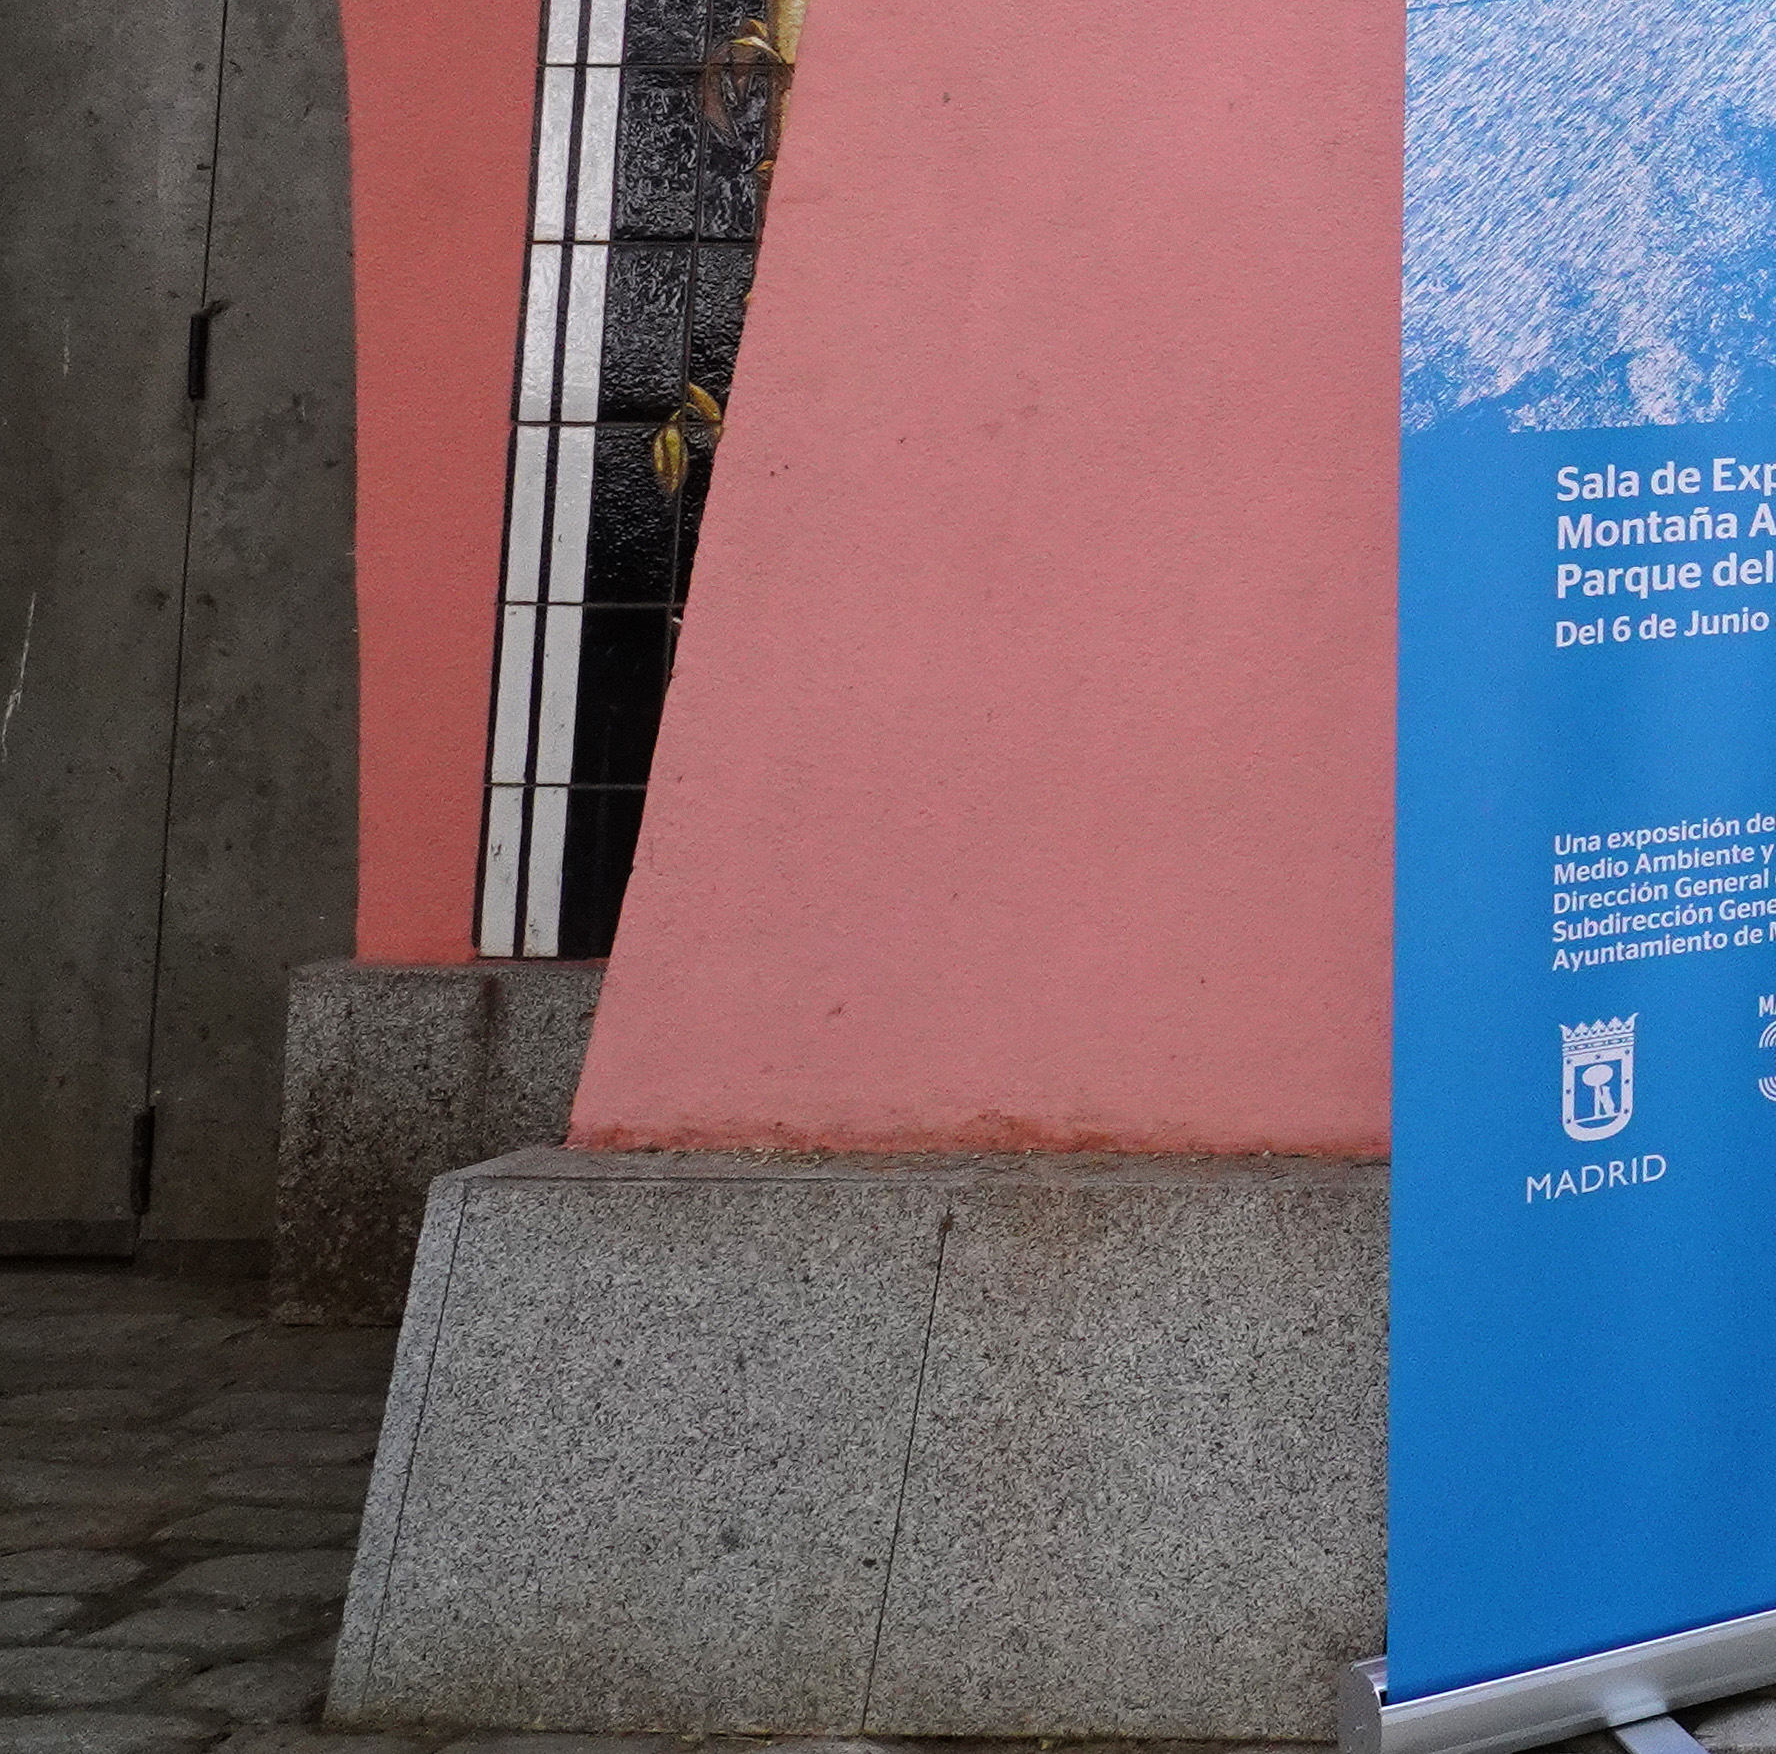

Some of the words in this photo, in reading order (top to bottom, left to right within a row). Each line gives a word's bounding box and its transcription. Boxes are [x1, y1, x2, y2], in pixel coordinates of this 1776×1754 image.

[1556, 464, 1640, 500] Sala
[1651, 461, 1701, 495] de
[1556, 510, 1738, 549] Montaña
[1556, 561, 1702, 599] Parque
[1713, 549, 1774, 586] del
[1556, 618, 1603, 647] Del
[1612, 616, 1632, 641] 6
[1638, 612, 1676, 640] de
[1684, 607, 1770, 637] Junio
[1555, 832, 1602, 856] Una
[1607, 816, 1740, 852] exposición
[1553, 860, 1630, 885] Medio
[1634, 845, 1756, 875] Ambiente
[1761, 846, 1774, 865] y
[1553, 884, 1669, 914] Dirección
[1674, 869, 1770, 899] General
[1552, 906, 1714, 943] Subdirección
[1552, 930, 1728, 972] Ayuntamiento
[1733, 924, 1763, 947] de
[1526, 1153, 1667, 1203] MADRID
